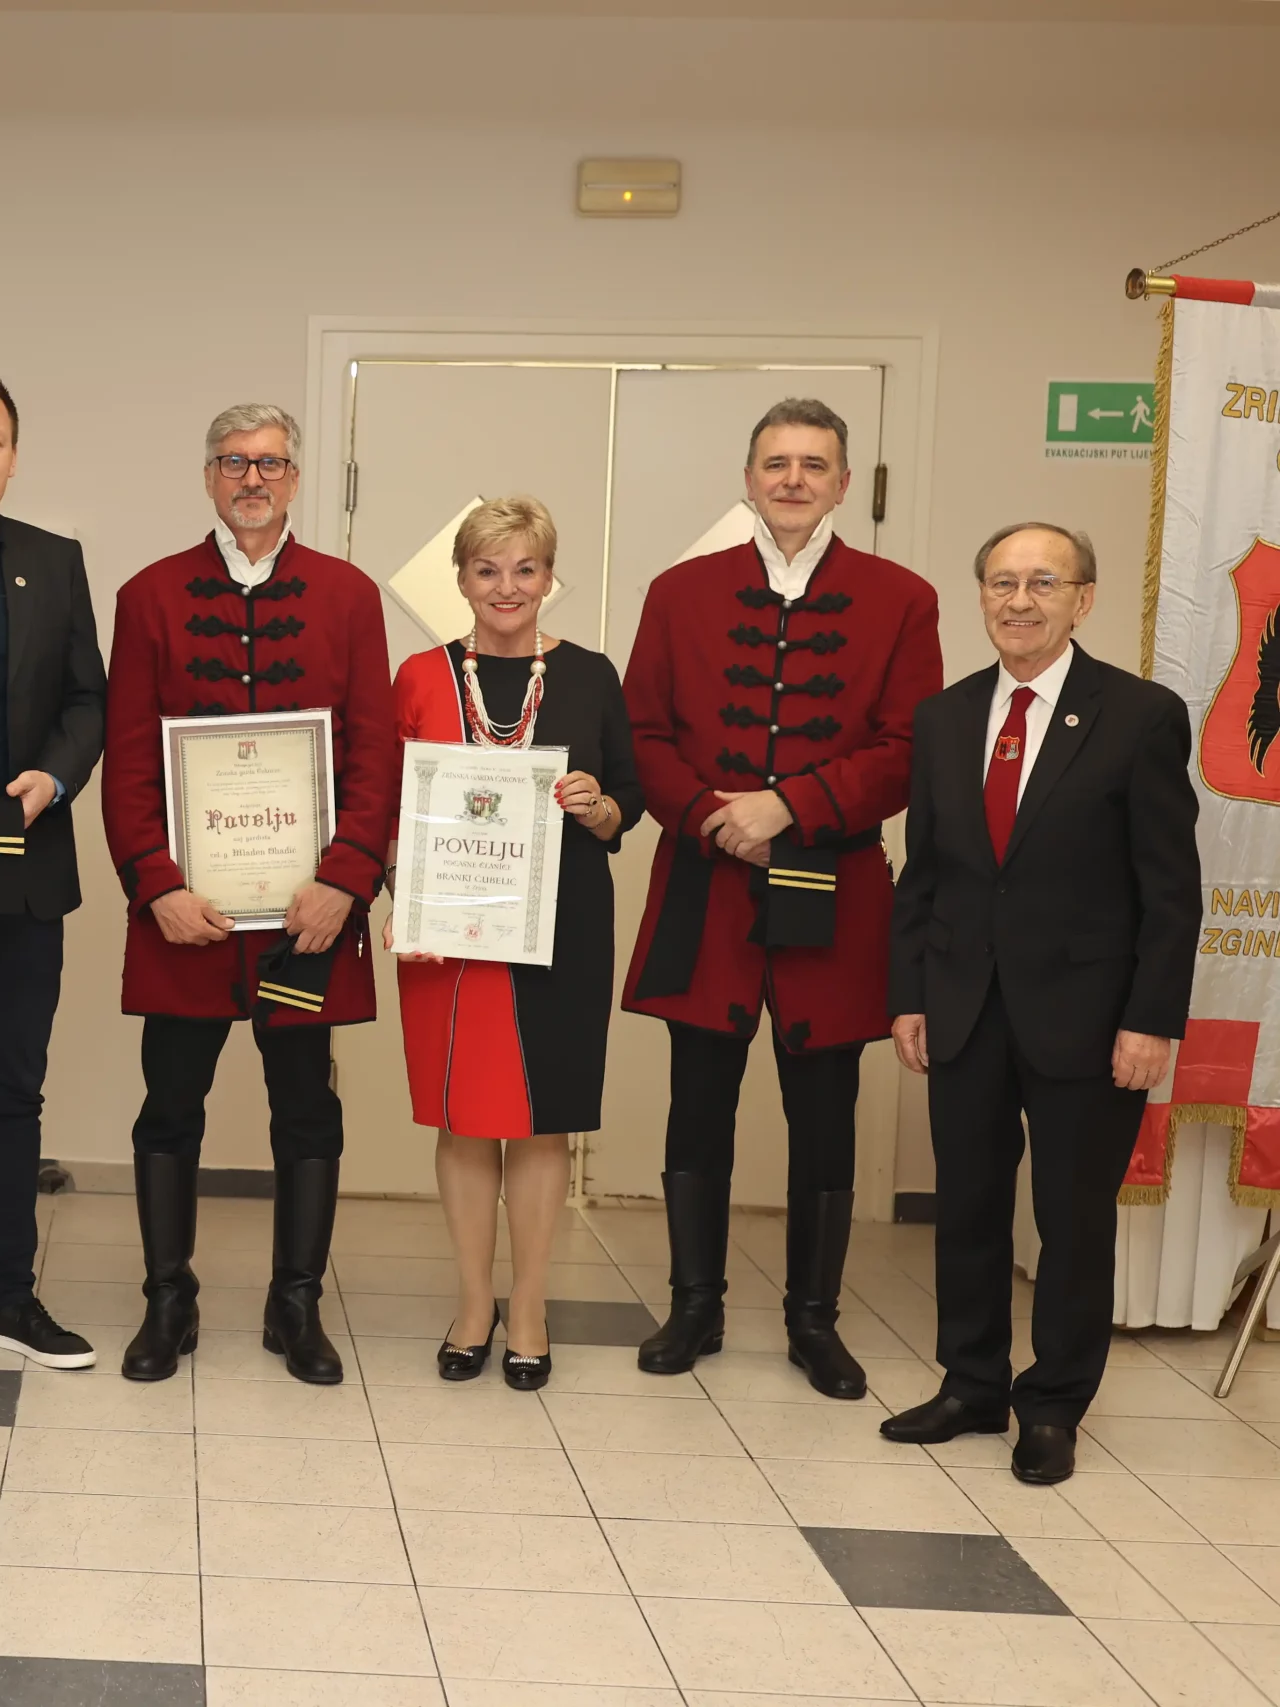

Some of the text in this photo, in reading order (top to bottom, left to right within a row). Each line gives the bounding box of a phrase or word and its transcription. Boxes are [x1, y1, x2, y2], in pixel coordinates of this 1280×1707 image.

[1221, 382, 1280, 424] ZRI
[1045, 448, 1108, 458] EVAKUACIJSKI
[1111, 449, 1128, 459] PUT
[205, 807, 297, 835] Povelju
[433, 836, 525, 861] POVELJU
[436, 872, 472, 882] BRANKI
